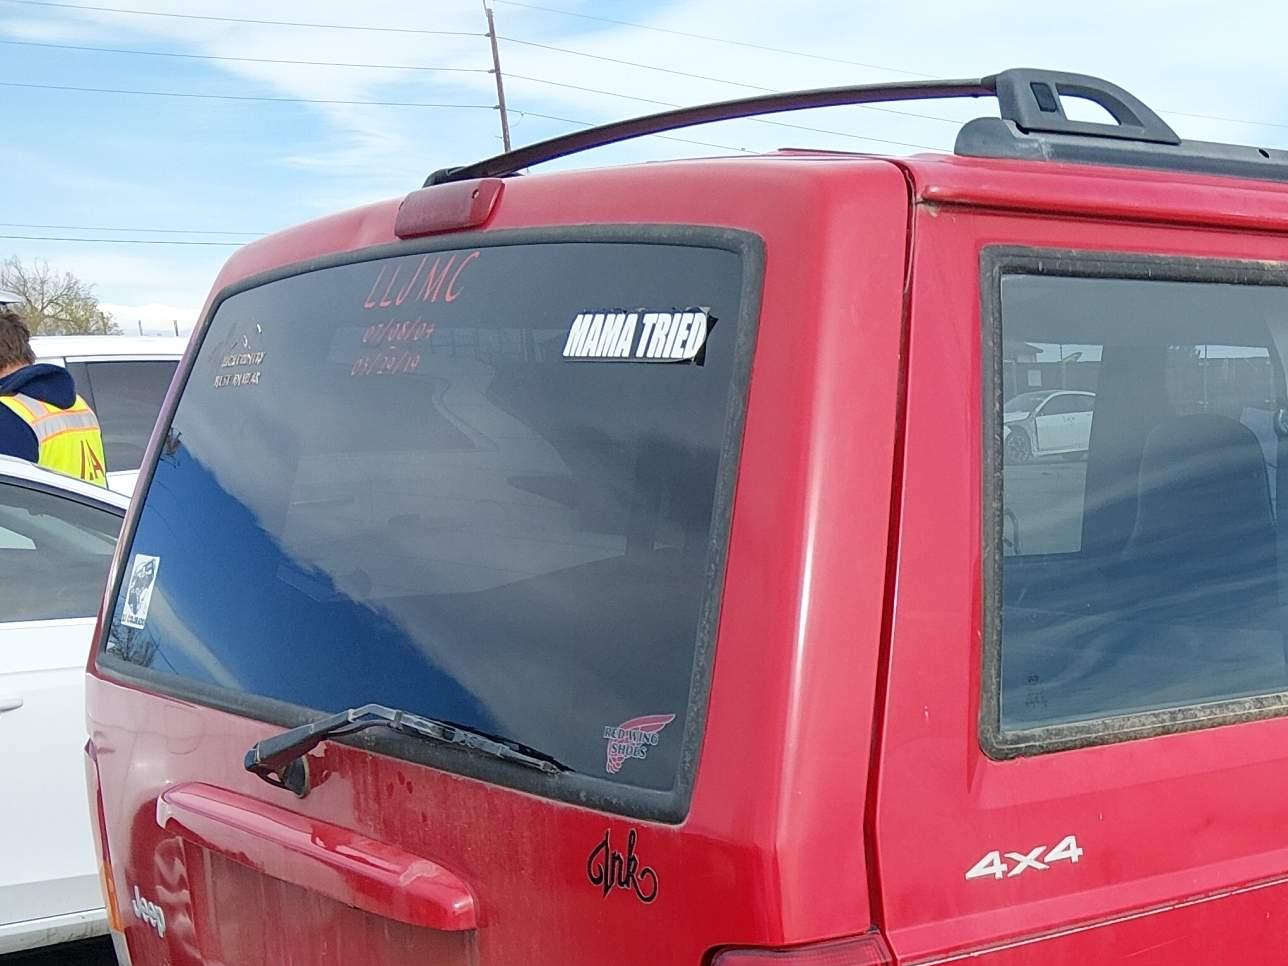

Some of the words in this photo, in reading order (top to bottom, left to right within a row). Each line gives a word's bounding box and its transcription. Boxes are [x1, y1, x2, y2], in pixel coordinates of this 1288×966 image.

[562, 313, 639, 358] MAMA
[635, 312, 707, 359] TRIED
[603, 726, 625, 740] RED
[626, 729, 660, 746] WING
[610, 742, 648, 759] SHOES
[131, 884, 167, 938] Jeep
